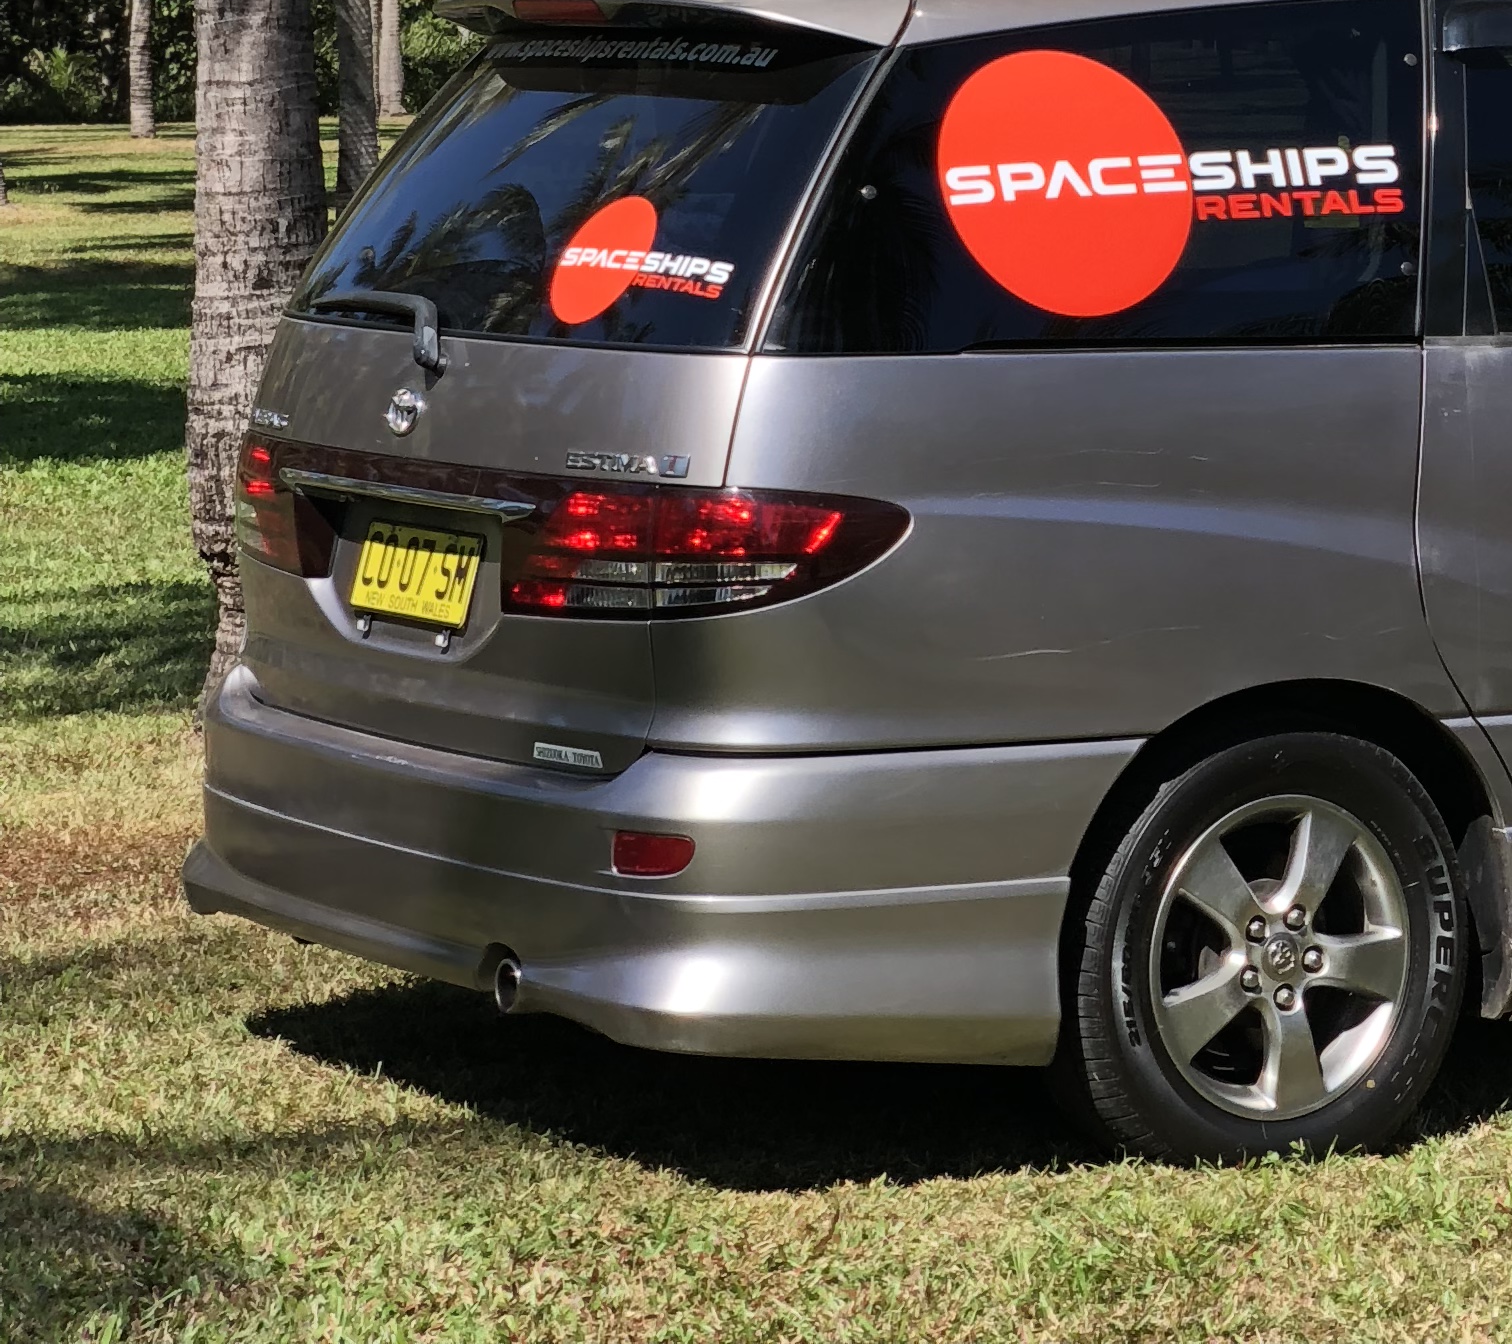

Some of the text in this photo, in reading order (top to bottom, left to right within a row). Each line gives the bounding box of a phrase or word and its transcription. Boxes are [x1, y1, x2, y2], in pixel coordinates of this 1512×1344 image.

[484, 34, 779, 68] www.spaceshipsrentals.com.au
[945, 145, 1400, 206] SPACESHIPS
[1195, 188, 1405, 221] RENTALS
[560, 246, 735, 285] SPACESHIPS
[631, 272, 725, 299] RENTALS
[364, 590, 451, 618] NEW SOUTH WALES
